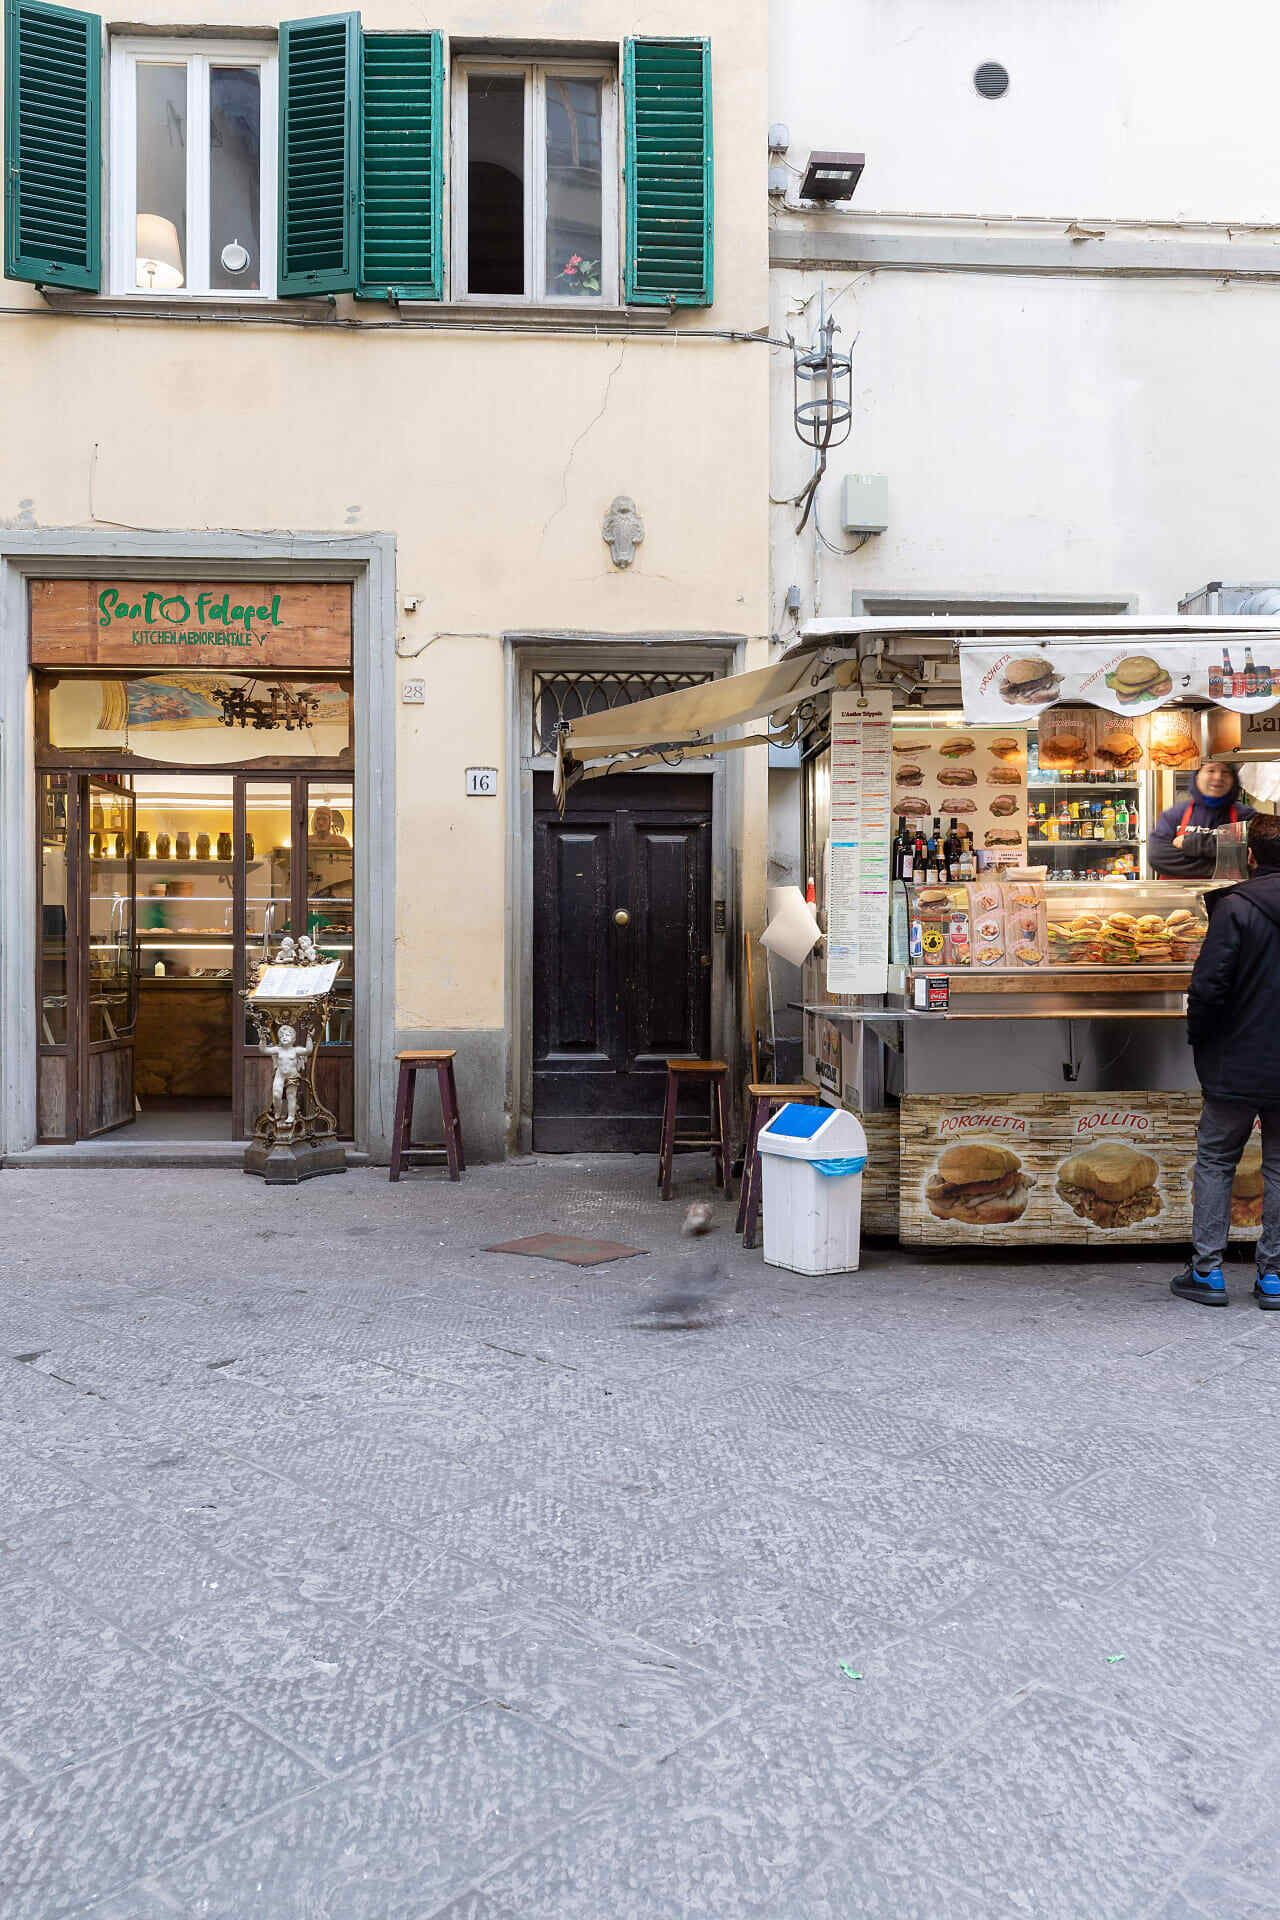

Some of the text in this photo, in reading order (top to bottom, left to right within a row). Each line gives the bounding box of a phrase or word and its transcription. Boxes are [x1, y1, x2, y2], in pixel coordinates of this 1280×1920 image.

[195, 591, 284, 631] Falafel
[132, 630, 252, 647] KITCHEN MEDIORIENTALE
[403, 685, 423, 698] 28
[1247, 713, 1280, 733] La
[472, 774, 490, 791] 16
[940, 1115, 1026, 1134] PORCHETTA
[1077, 1112, 1150, 1133] BOLLITO
